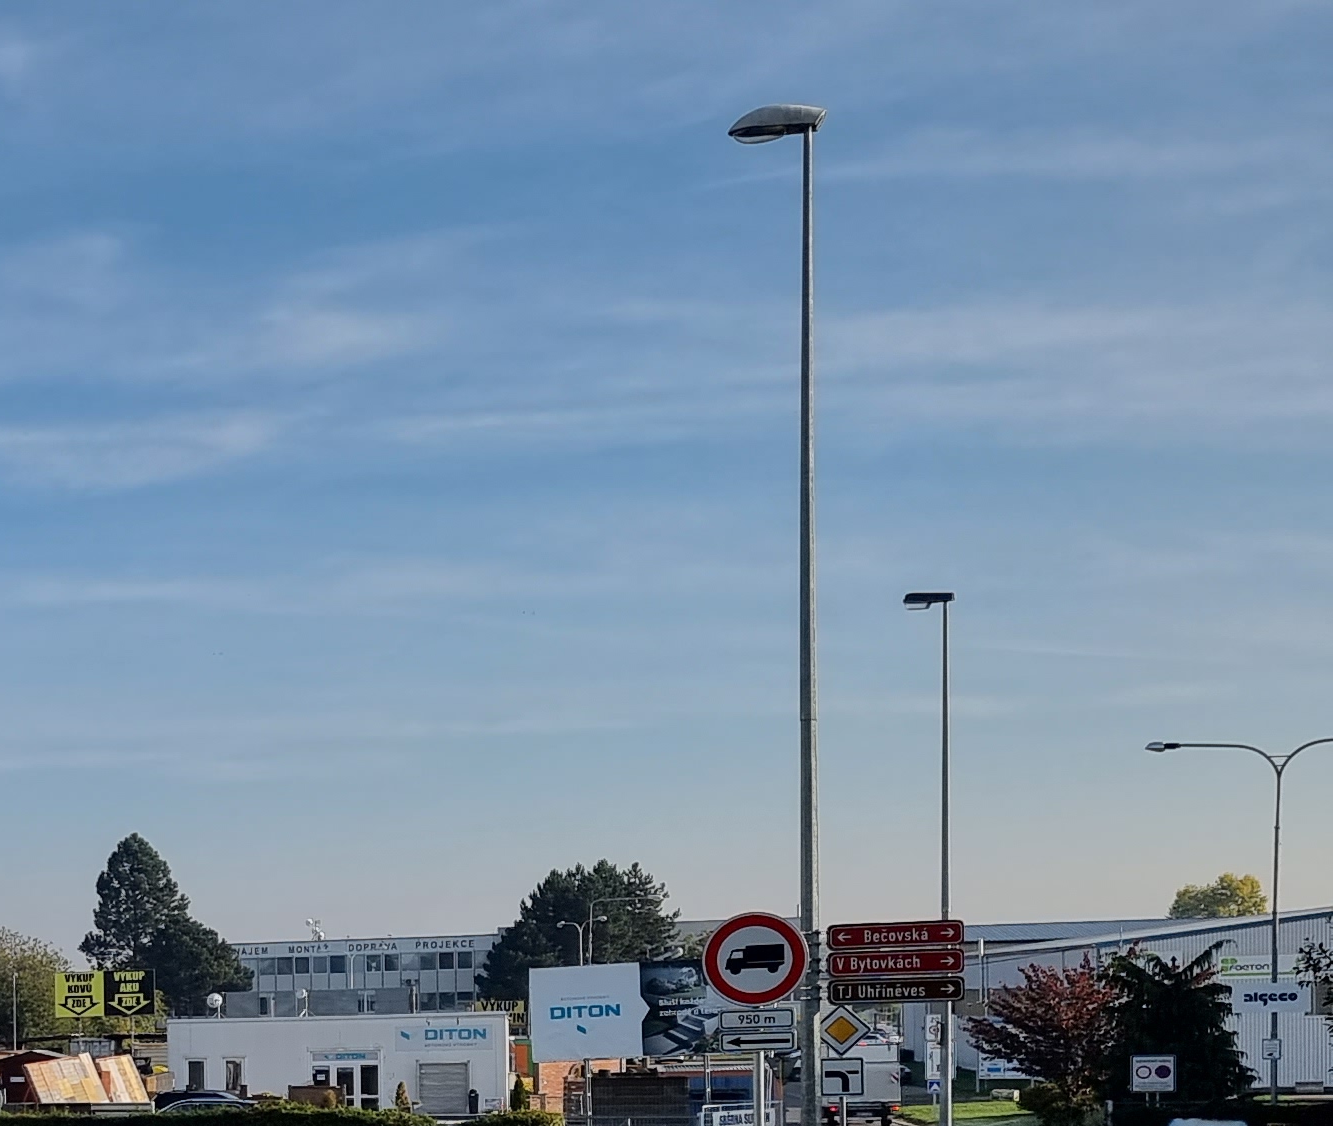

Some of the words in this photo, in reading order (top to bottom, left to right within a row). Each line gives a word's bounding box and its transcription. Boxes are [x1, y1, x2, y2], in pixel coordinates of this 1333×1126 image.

[863, 928, 929, 943] Bečovská
[415, 938, 475, 950] PROJEKCE
[836, 957, 845, 971] V
[850, 956, 921, 975] Bytovkách
[837, 984, 852, 999] TJ
[858, 981, 926, 999] Uhříněves
[549, 1003, 621, 1020] DITON
[737, 1014, 761, 1026] 950
[763, 1016, 777, 1025] m
[424, 1027, 487, 1041] DITON
[335, 1052, 366, 1060] DITON
